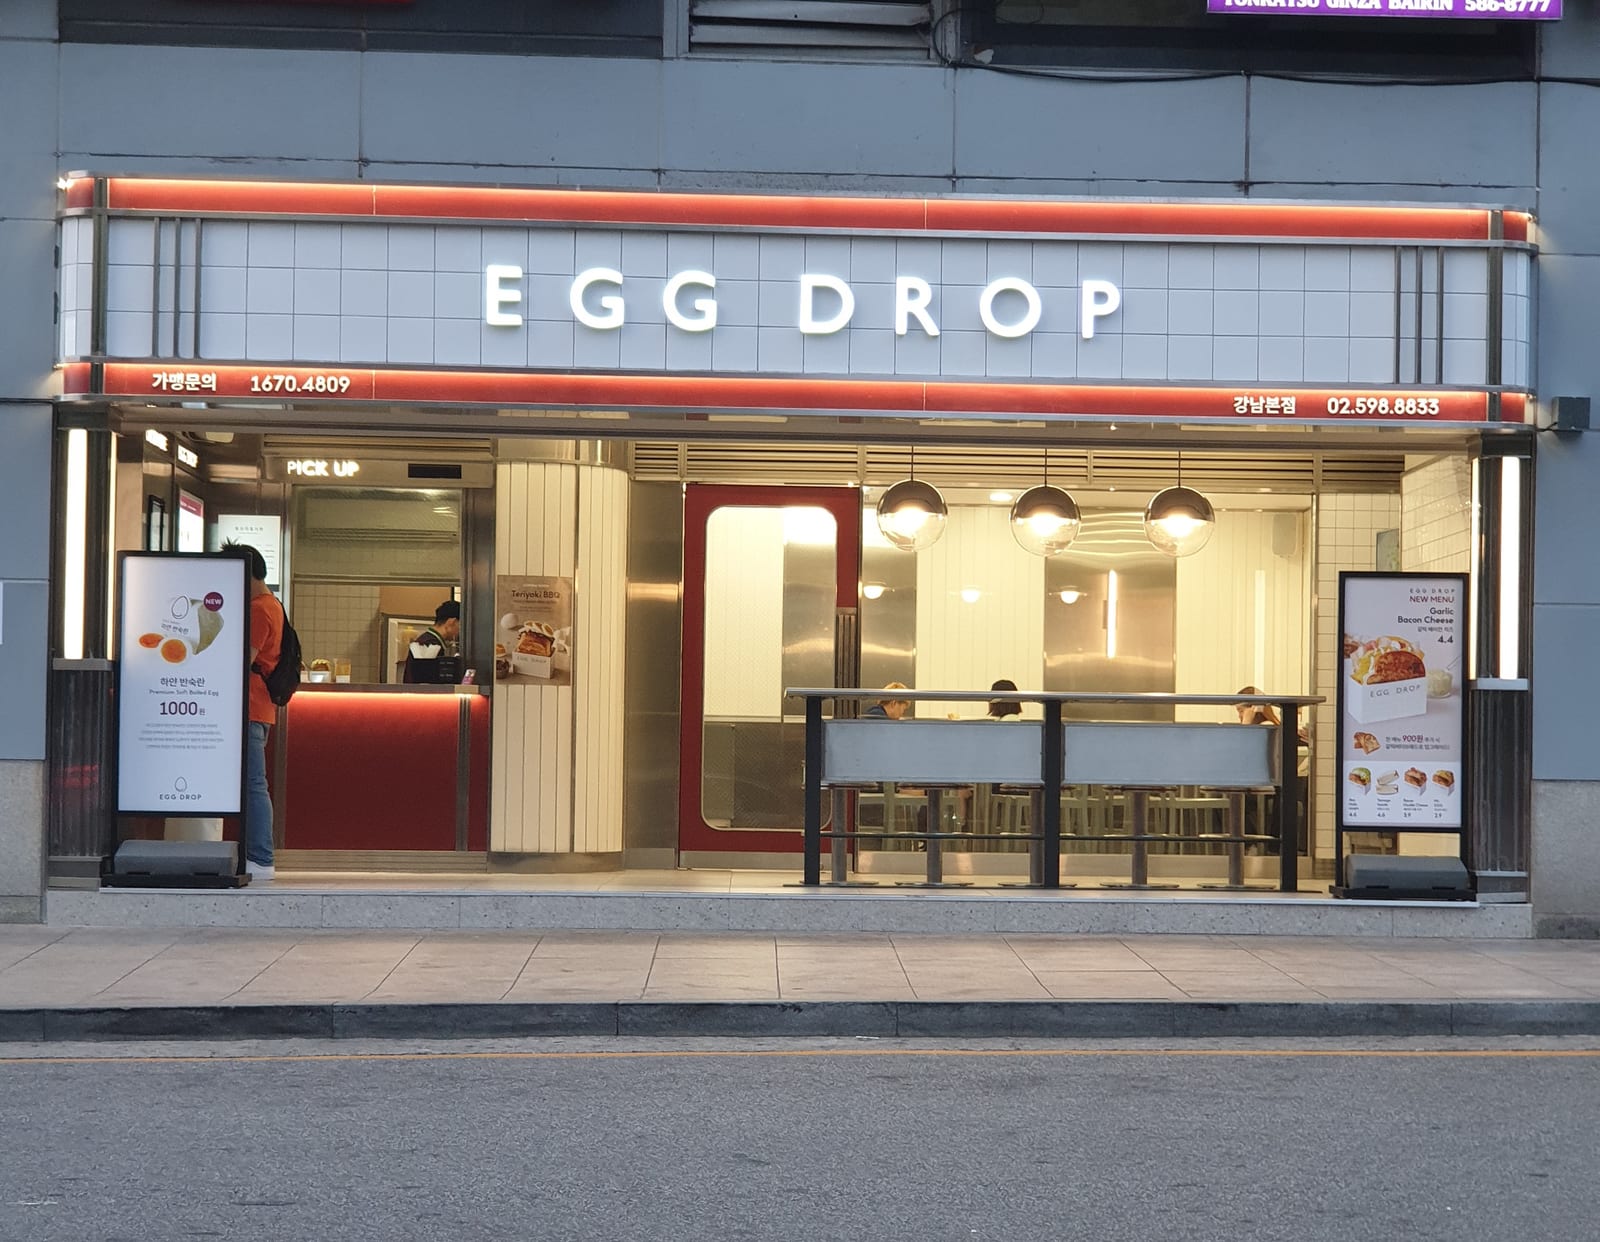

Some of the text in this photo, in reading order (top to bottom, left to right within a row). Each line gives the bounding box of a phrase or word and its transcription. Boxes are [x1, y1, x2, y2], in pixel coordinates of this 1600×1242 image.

[486, 264, 1121, 340] EGG DROP
[152, 372, 350, 393] 가맹문의 1670.4809
[1233, 396, 1440, 415] 강남본점 02.598.8833
[287, 460, 360, 477] PICK UP
[511, 590, 561, 600] Teriyaki BBQ
[1409, 595, 1455, 603] NEW MENU
[1429, 607, 1454, 615] Garlic
[1397, 616, 1454, 624] Bacon Cheese
[1437, 635, 1454, 644] 4.4
[179, 677, 206, 688] 반숙란
[1370, 684, 1420, 698] EGG DROP
